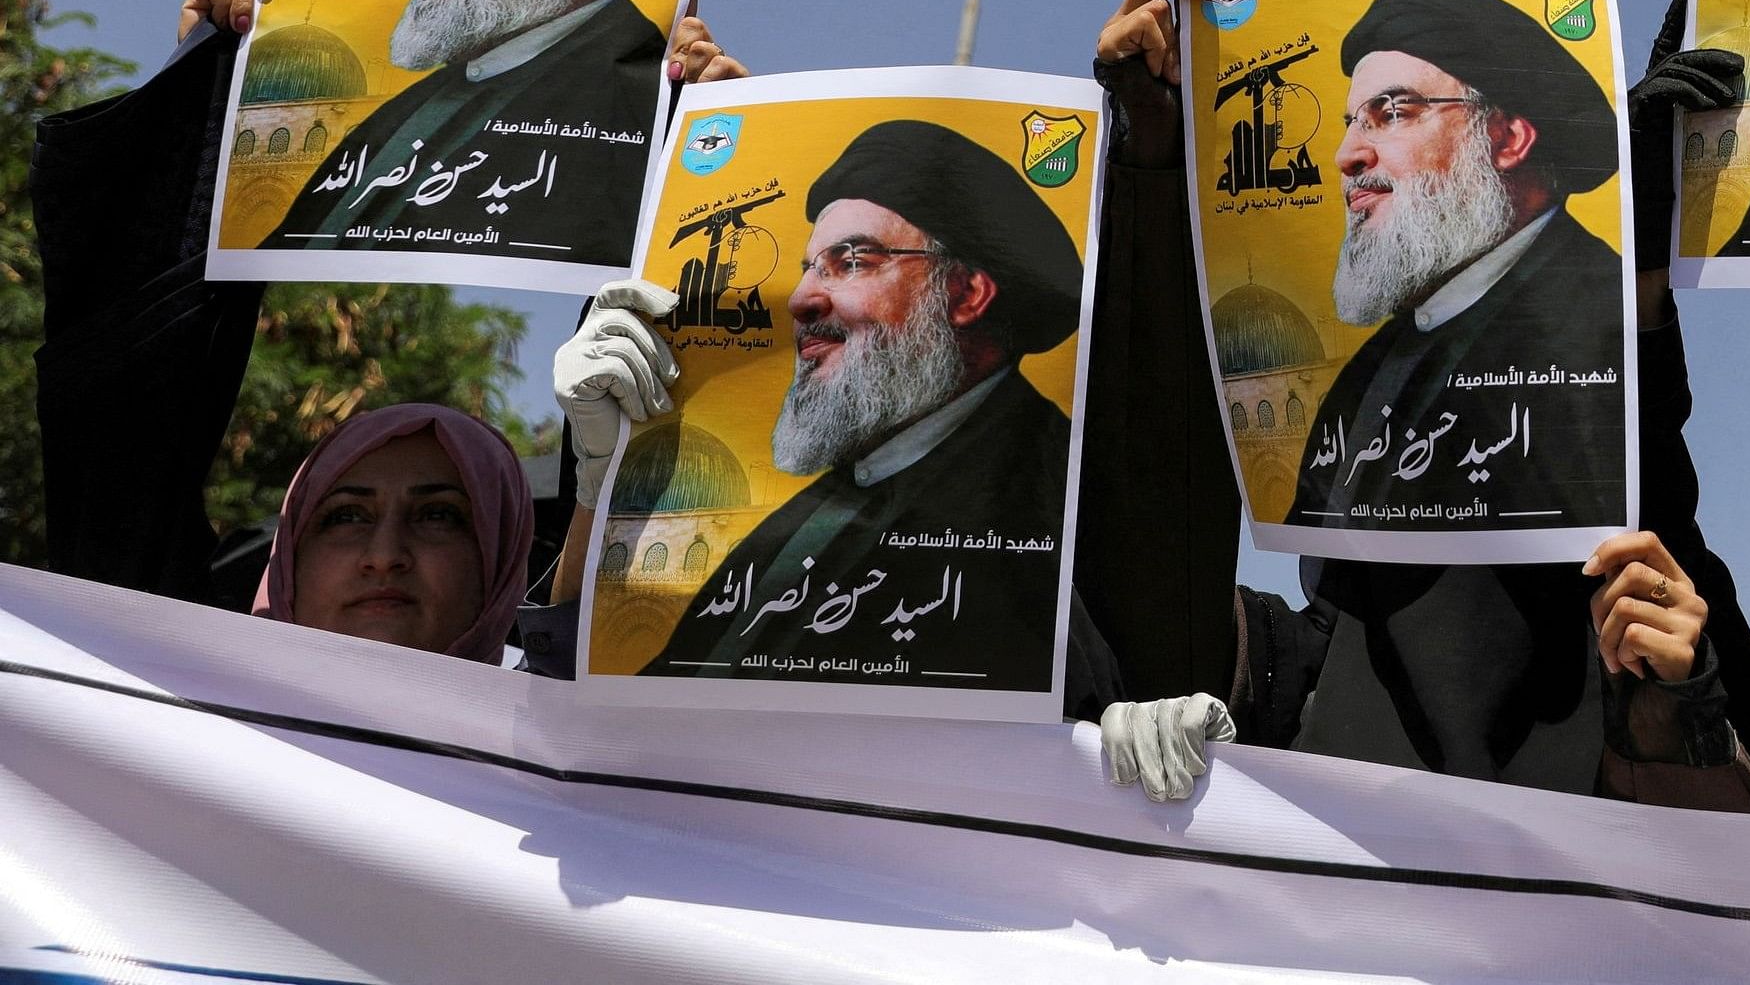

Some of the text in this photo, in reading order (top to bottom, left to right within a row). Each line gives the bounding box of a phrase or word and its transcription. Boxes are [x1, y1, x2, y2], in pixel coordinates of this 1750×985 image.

[312, 138, 558, 216] السيد حسن نصر الله
[1215, 195, 1323, 215] المقاومة الإسلامية في لبنان
[344, 226, 500, 245] الأمين العام لحزب الله
[676, 334, 691, 350] في
[693, 335, 734, 352] الإسلامية
[737, 337, 773, 352] المقاومة
[1309, 401, 1530, 487] السيد حسن نصر الله
[1350, 497, 1488, 521] الأمين العام لحزب الله
[698, 555, 962, 642] السيد حسن نصر الله
[740, 654, 910, 674] الأمين العام لحزب الله
